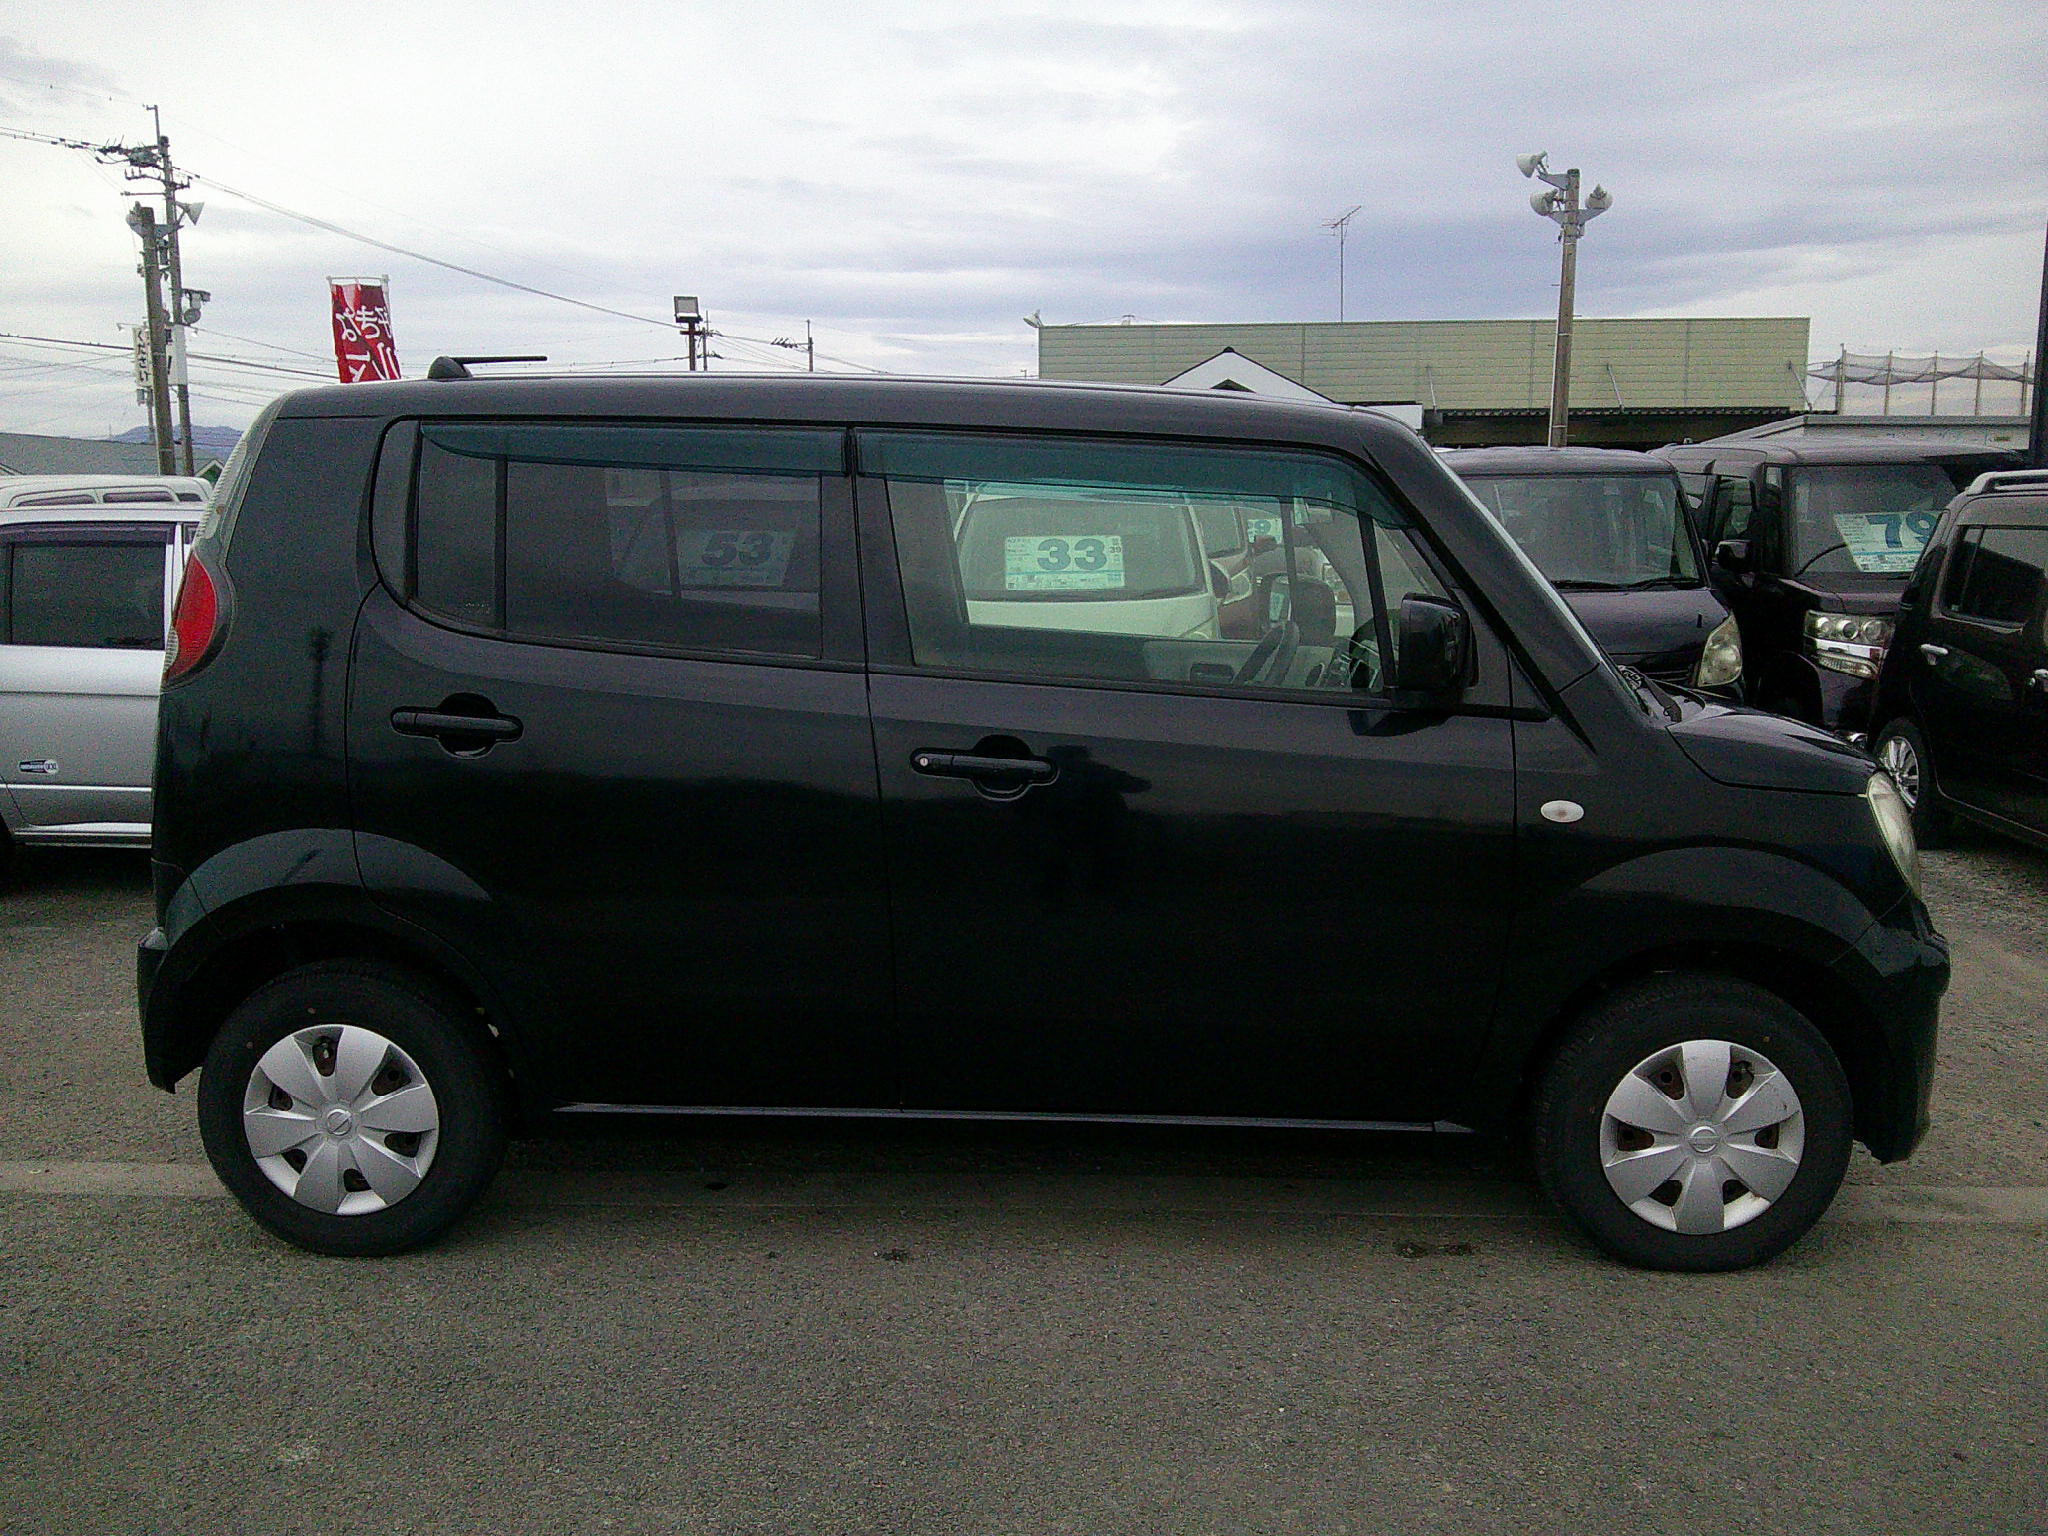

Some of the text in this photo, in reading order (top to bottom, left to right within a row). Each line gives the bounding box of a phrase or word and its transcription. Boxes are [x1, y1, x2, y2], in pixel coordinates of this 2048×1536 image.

[137, 330, 149, 382] ください
[1865, 511, 1939, 548] 79
[701, 532, 773, 567] 53
[1037, 538, 1107, 571] 33
